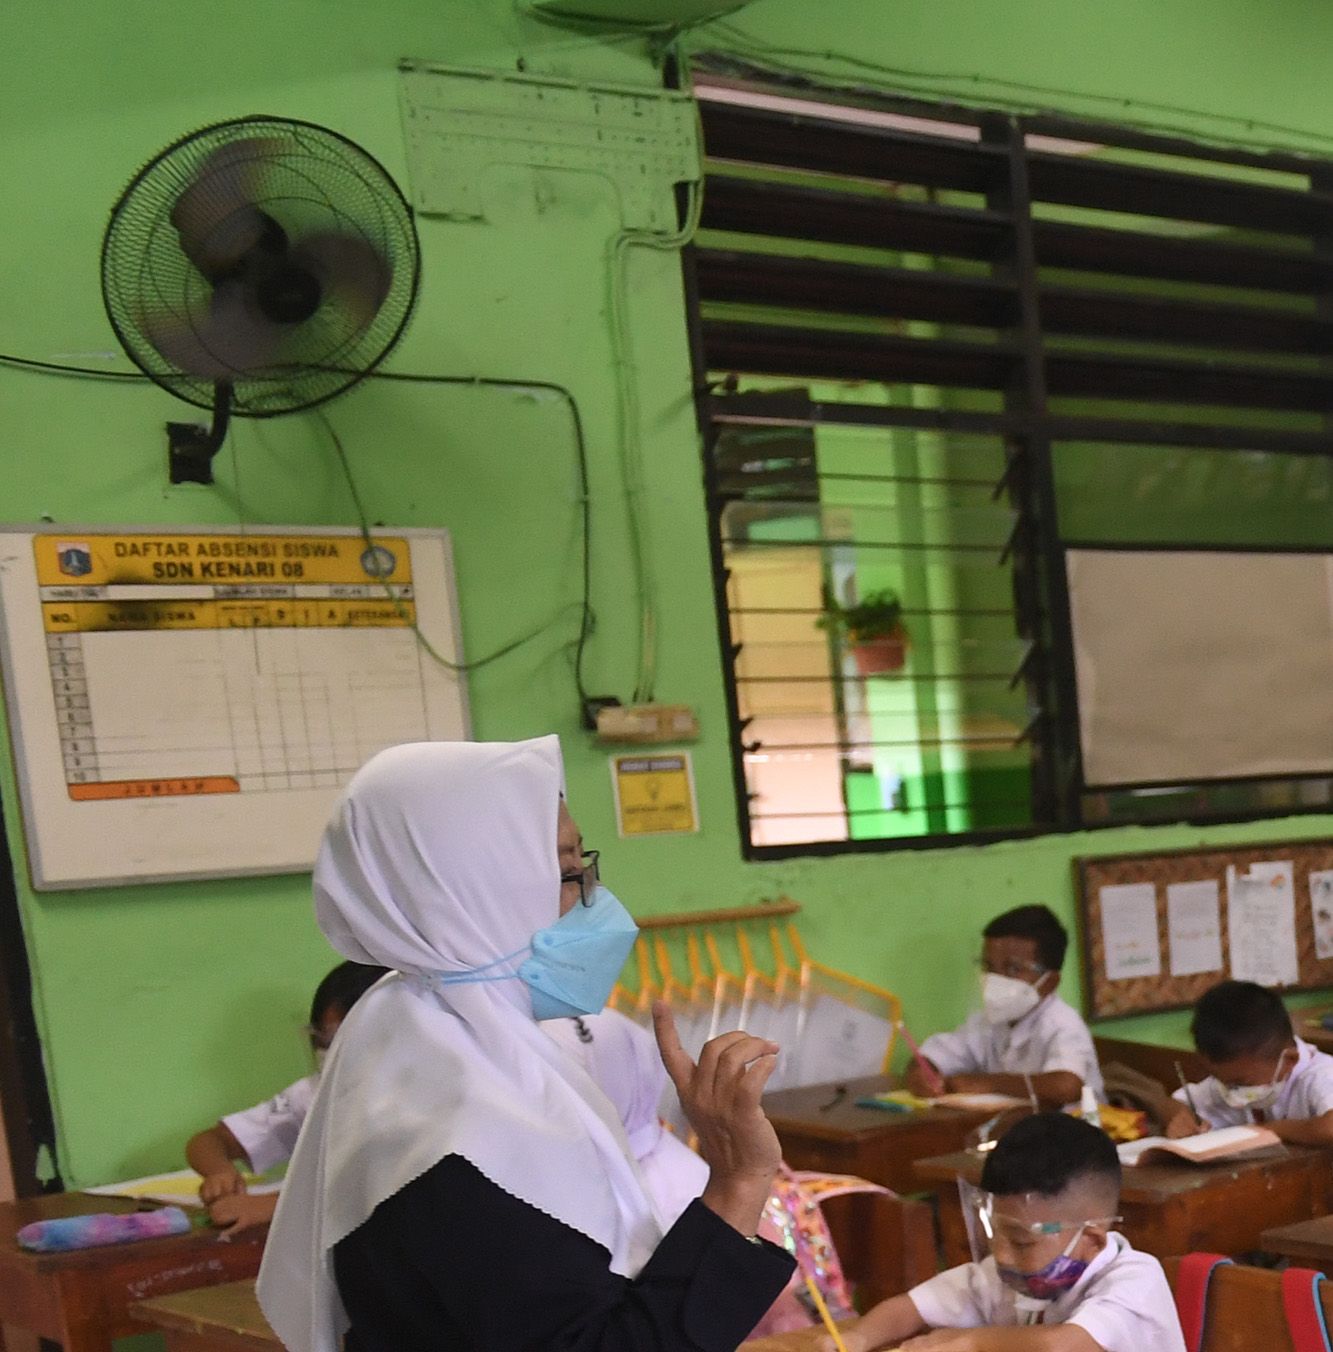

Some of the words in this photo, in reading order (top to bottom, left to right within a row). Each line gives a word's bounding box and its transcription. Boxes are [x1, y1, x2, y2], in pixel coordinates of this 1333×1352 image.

[115, 542, 190, 557] DAFTAR
[197, 542, 277, 557] ABSENSI
[283, 543, 339, 557] SISWA
[153, 562, 194, 578] SDN
[201, 562, 275, 578] KENARI
[282, 562, 304, 578] 08
